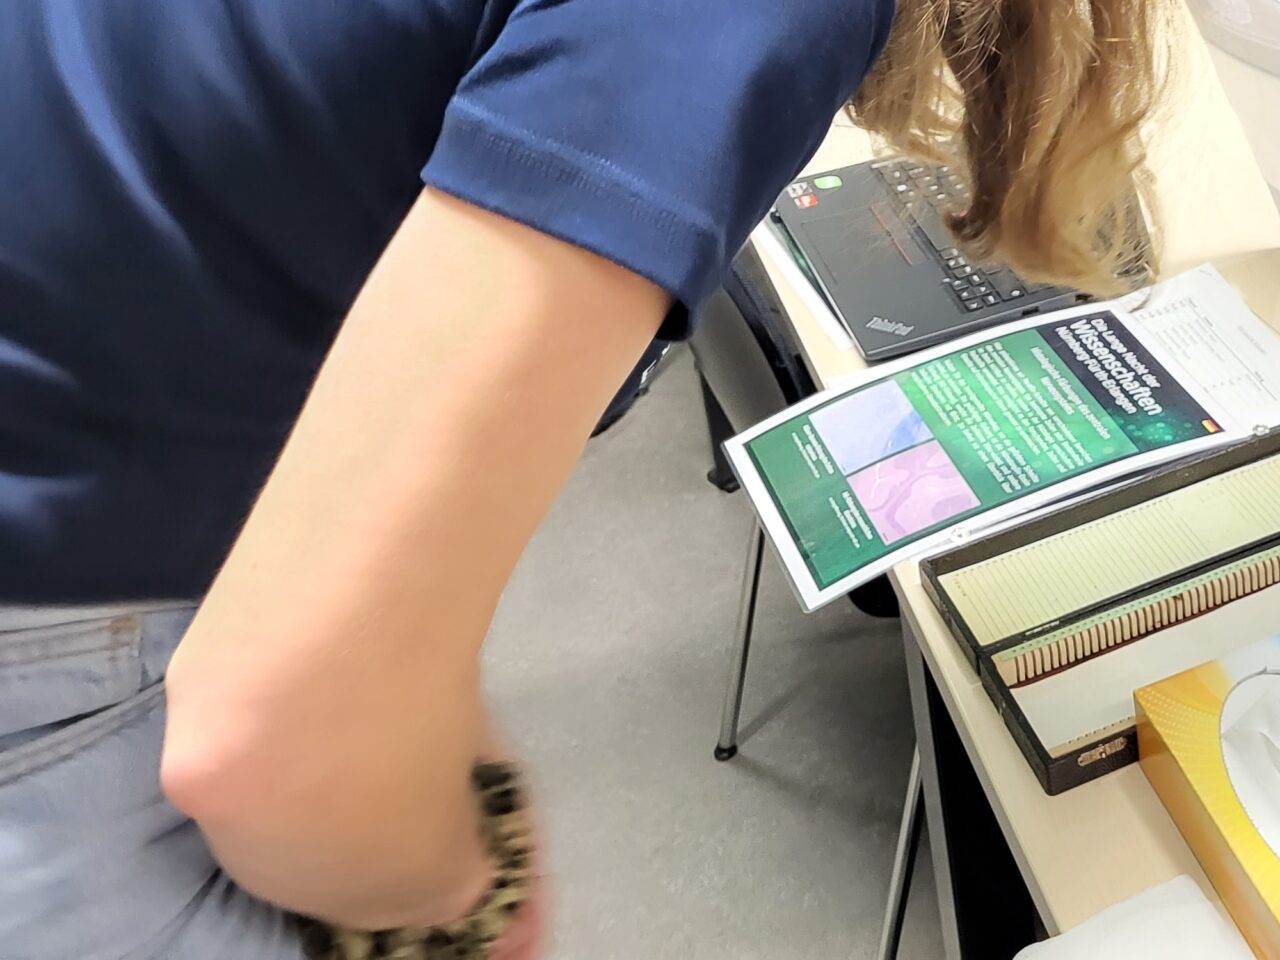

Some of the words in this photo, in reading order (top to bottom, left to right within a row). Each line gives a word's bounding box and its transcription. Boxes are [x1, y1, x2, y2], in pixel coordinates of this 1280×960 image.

[866, 316, 915, 337] ThinkPad
[1091, 318, 1107, 332] Die
[1103, 331, 1127, 354] Lange
[1123, 352, 1149, 377] Nacht
[1142, 372, 1161, 388] der
[1070, 319, 1163, 416] Wissenschaften
